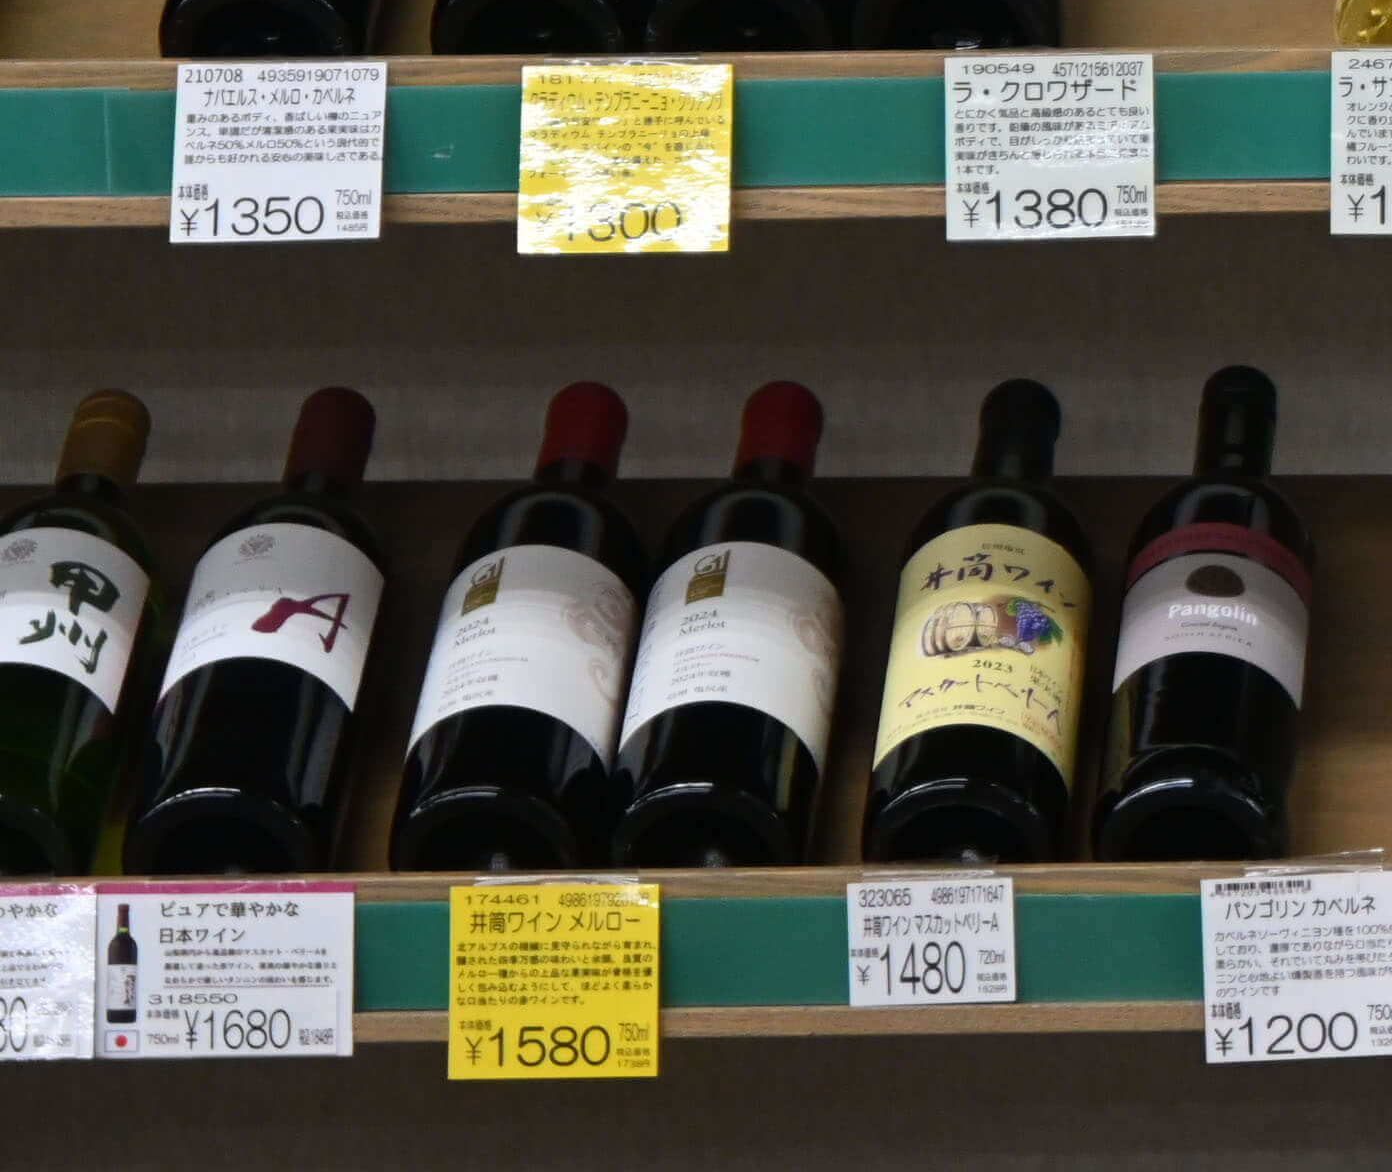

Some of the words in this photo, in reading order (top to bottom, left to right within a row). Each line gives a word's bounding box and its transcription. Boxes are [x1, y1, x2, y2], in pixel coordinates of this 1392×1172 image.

[185, 69, 243, 84] 210708
[257, 69, 380, 83] 4935919071079
[962, 63, 1035, 75] 190549
[1052, 61, 1144, 78] 4571215612037
[952, 78, 1137, 103] ラ・クロワザード
[335, 189, 373, 207] 750ml
[1116, 185, 1148, 204] 750ml
[179, 195, 325, 237] ¥1350
[962, 187, 1108, 230] ¥1380
[536, 201, 682, 243] 300
[1168, 602, 1257, 626] Pangolin
[973, 659, 1014, 674] 2023
[465, 894, 540, 906] 174461
[859, 888, 912, 908] 323065
[1225, 898, 1305, 920] パンゴリン
[1312, 895, 1377, 917] カベルネ
[160, 901, 300, 918] ピュアで華やかな
[470, 911, 562, 934] 井筒ワイン
[568, 911, 641, 933] メルロー
[159, 928, 245, 944] 日本ワイン
[977, 950, 1006, 965] 720ml
[857, 940, 966, 996] ¥1480
[148, 992, 238, 1005] 318550
[147, 1033, 180, 1046] 750ml
[184, 1009, 291, 1050] ¥1680
[618, 1022, 649, 1042] 750ml
[1214, 1012, 1358, 1057] ¥1200
[465, 1025, 611, 1067] ¥1580
